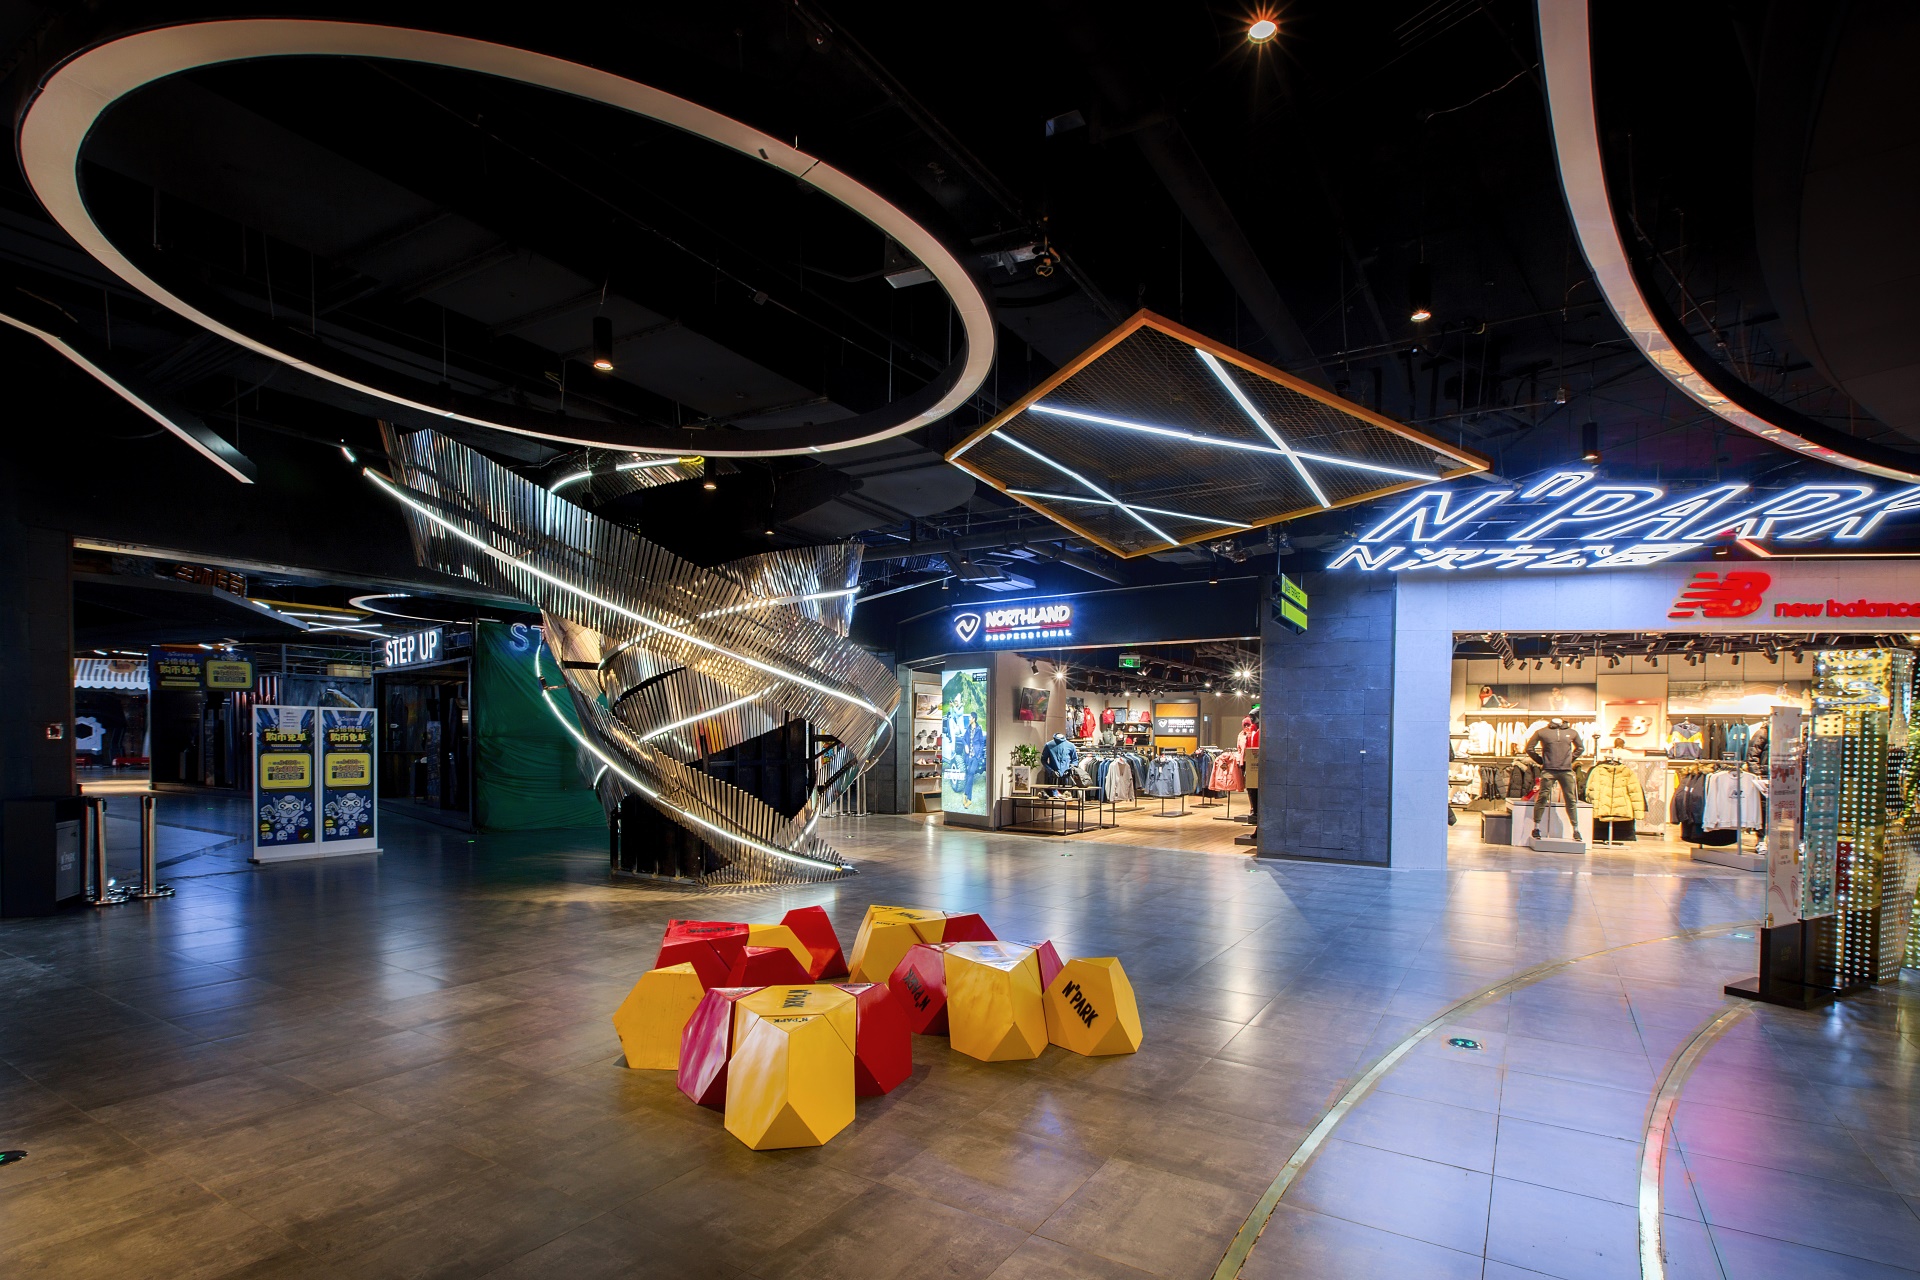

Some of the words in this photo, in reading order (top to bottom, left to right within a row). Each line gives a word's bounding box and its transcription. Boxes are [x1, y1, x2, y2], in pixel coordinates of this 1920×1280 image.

[985, 605, 1071, 627] NORTHLAND
[1774, 602, 1825, 618] new
[985, 630, 1072, 641] PROFESSIONAL
[385, 636, 415, 666] STEP
[419, 631, 437, 660] UP
[330, 733, 367, 742] 购币免单
